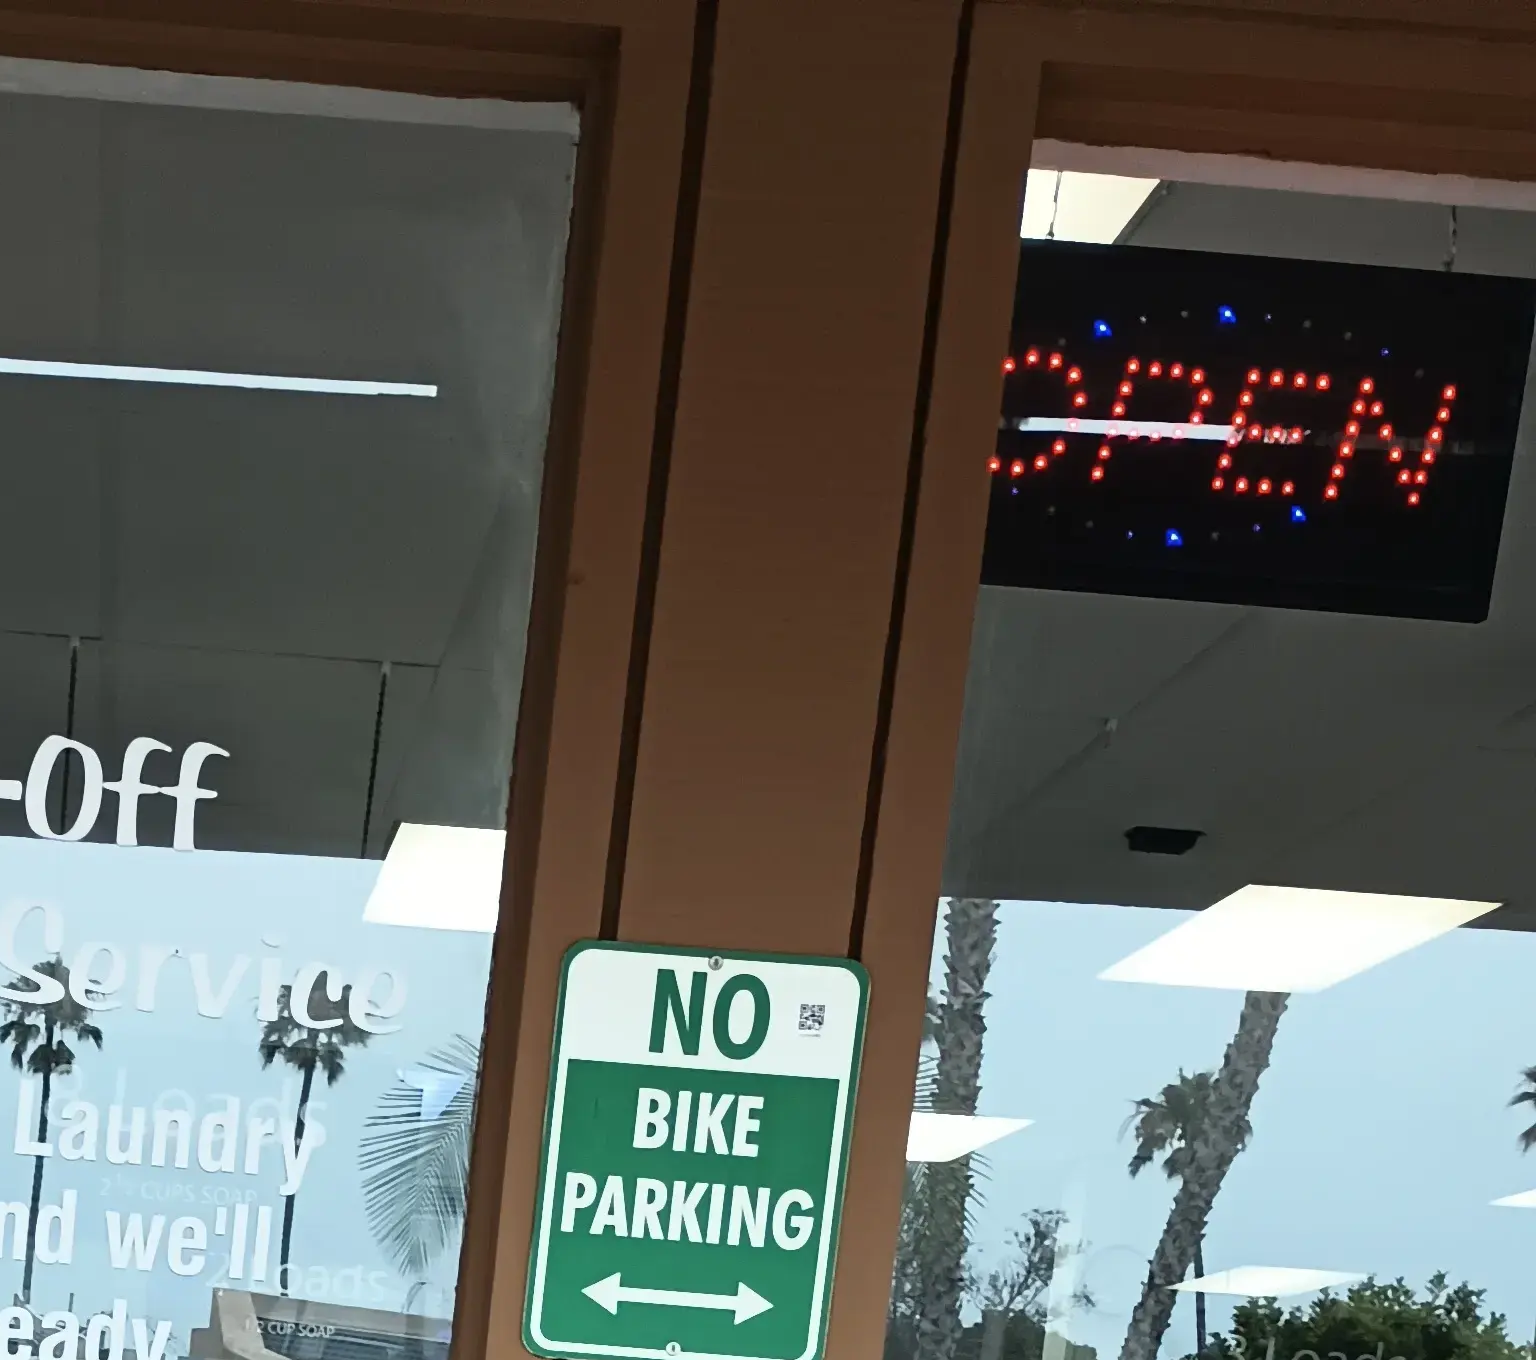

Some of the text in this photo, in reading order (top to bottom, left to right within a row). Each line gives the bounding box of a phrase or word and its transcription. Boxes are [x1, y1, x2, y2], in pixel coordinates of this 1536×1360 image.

[986, 347, 1456, 506] OPEN
[648, 968, 771, 1061] NO
[14, 1076, 314, 1196] Laundry
[632, 1087, 764, 1158] BIKE
[105, 1203, 273, 1283] we'll
[560, 1171, 814, 1251] PARKING
[298, 1324, 335, 1338] SOAP
